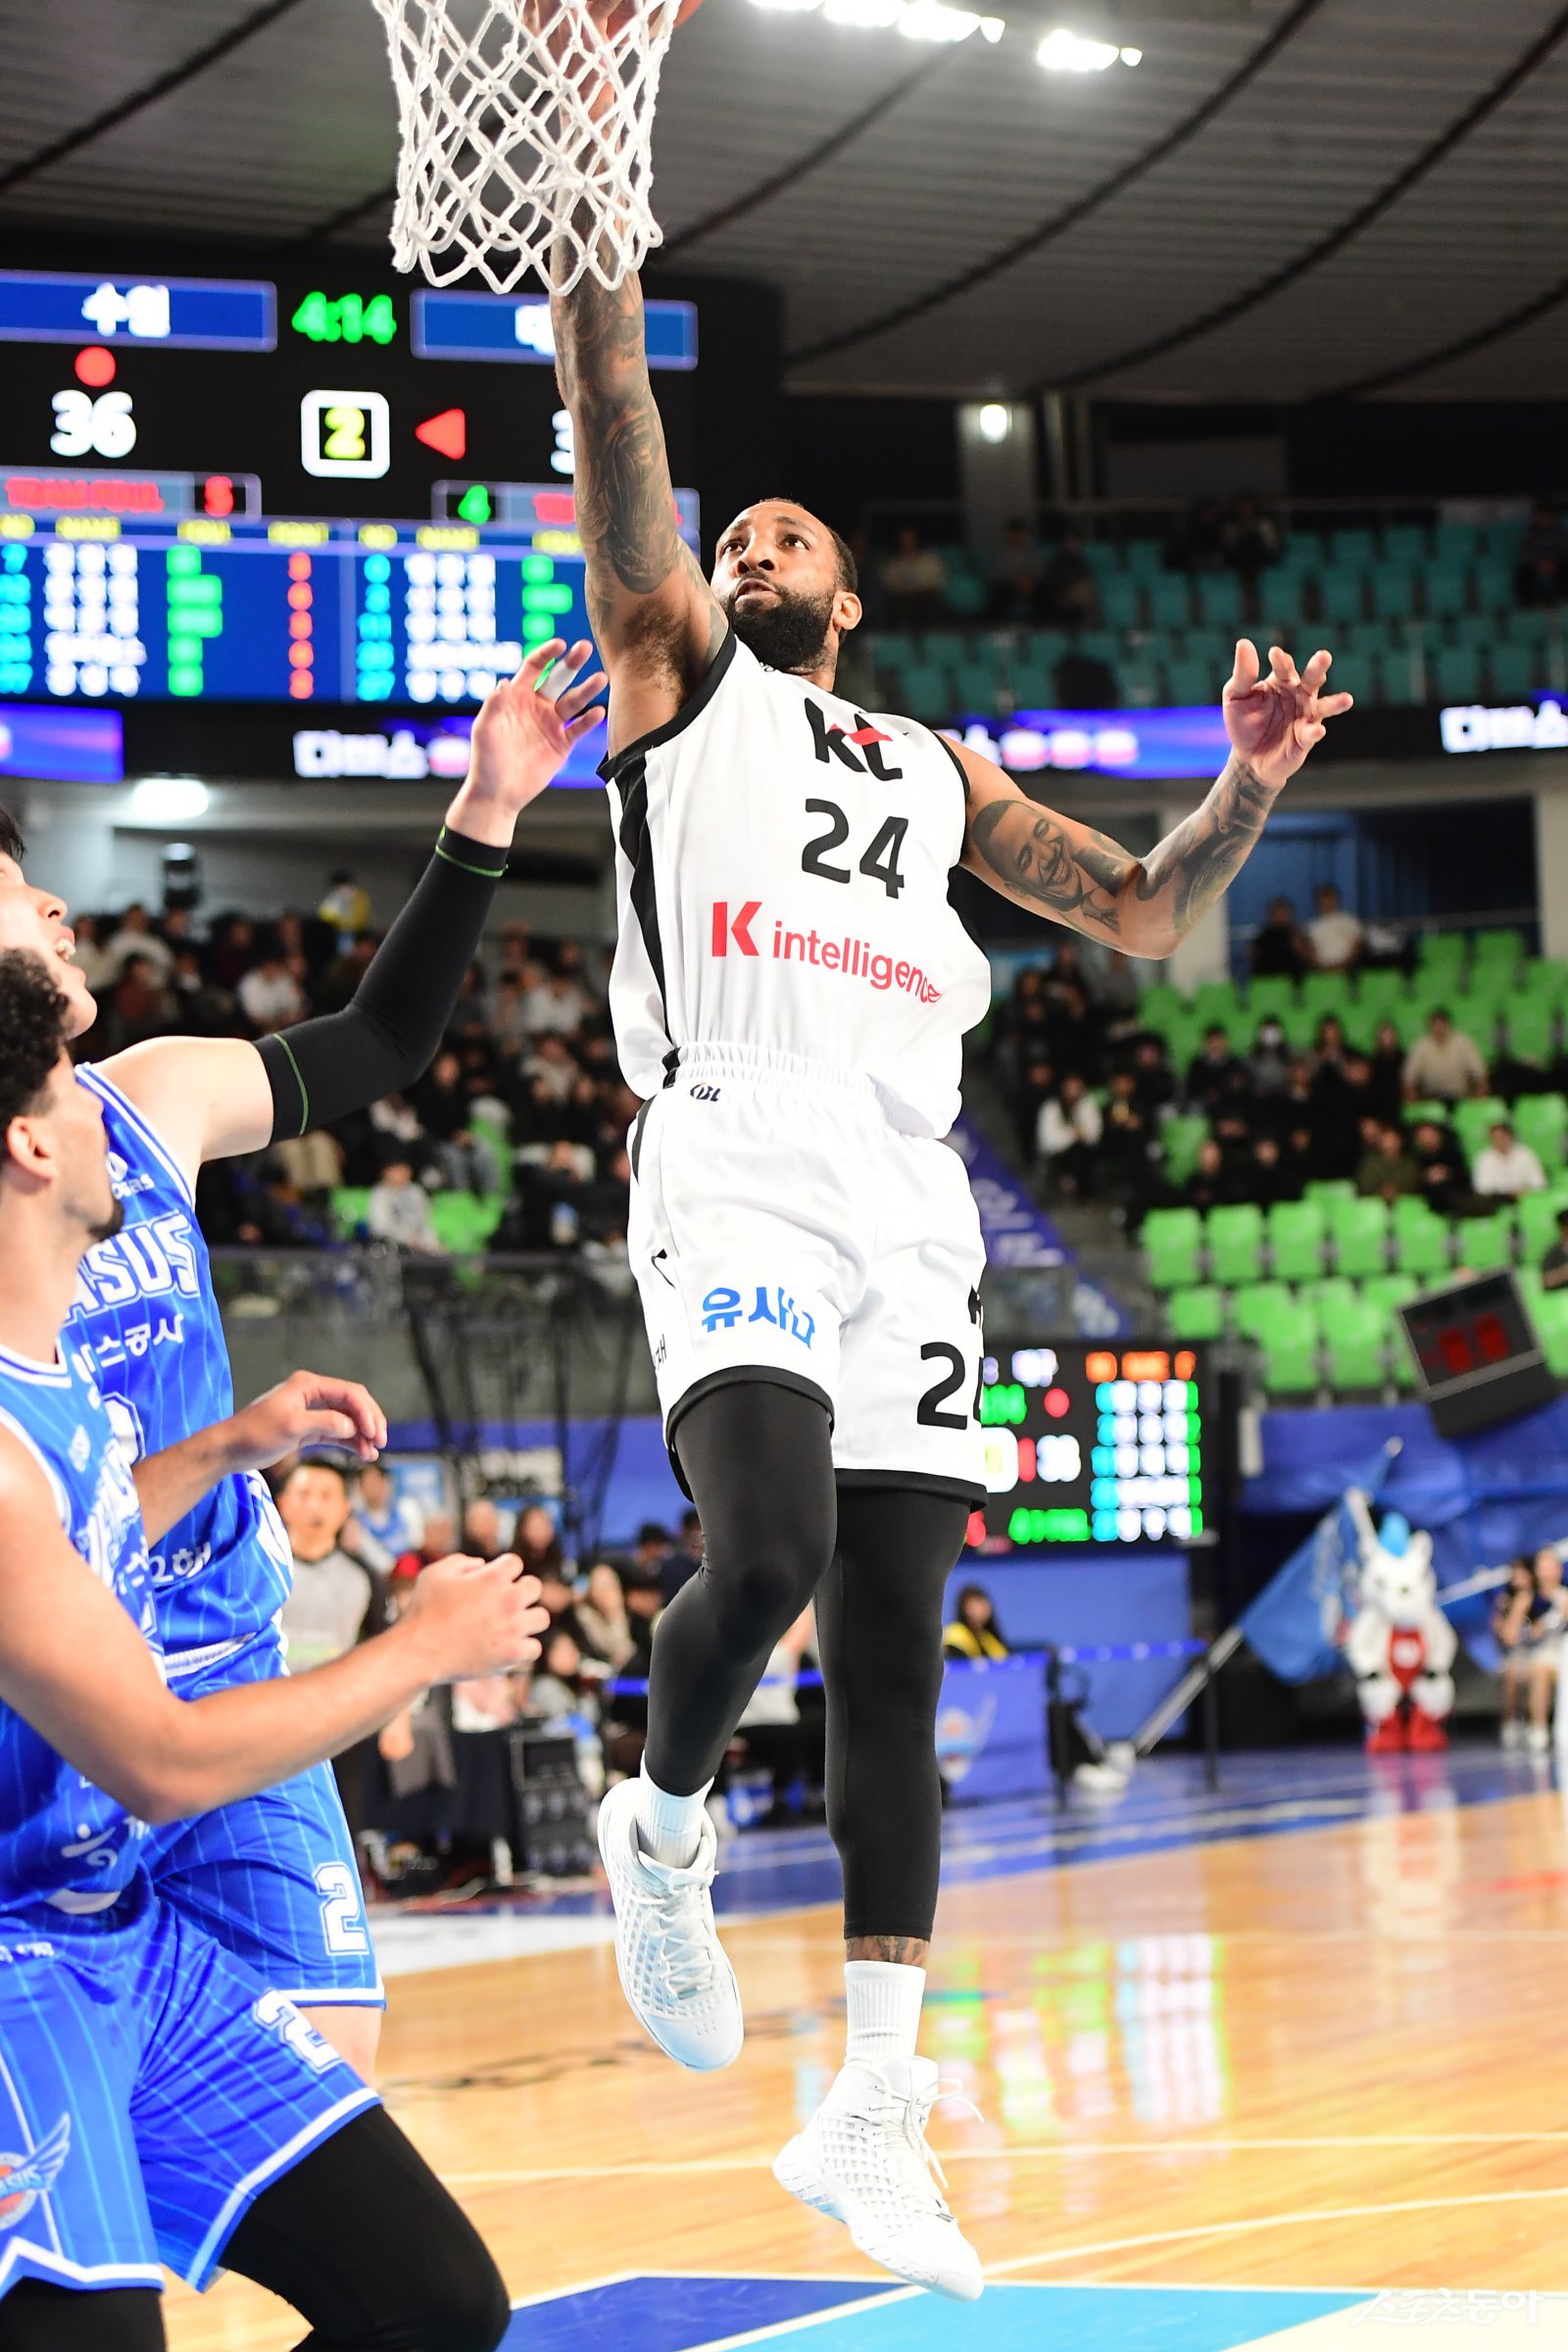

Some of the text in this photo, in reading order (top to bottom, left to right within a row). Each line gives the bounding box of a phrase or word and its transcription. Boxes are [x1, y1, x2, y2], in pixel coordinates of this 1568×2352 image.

[292, 291, 397, 345] 4:14
[50, 389, 136, 458] 36
[323, 406, 367, 461] 2
[801, 798, 909, 900] 24
[711, 901, 763, 957] K
[315, 1862, 370, 1956] 2
